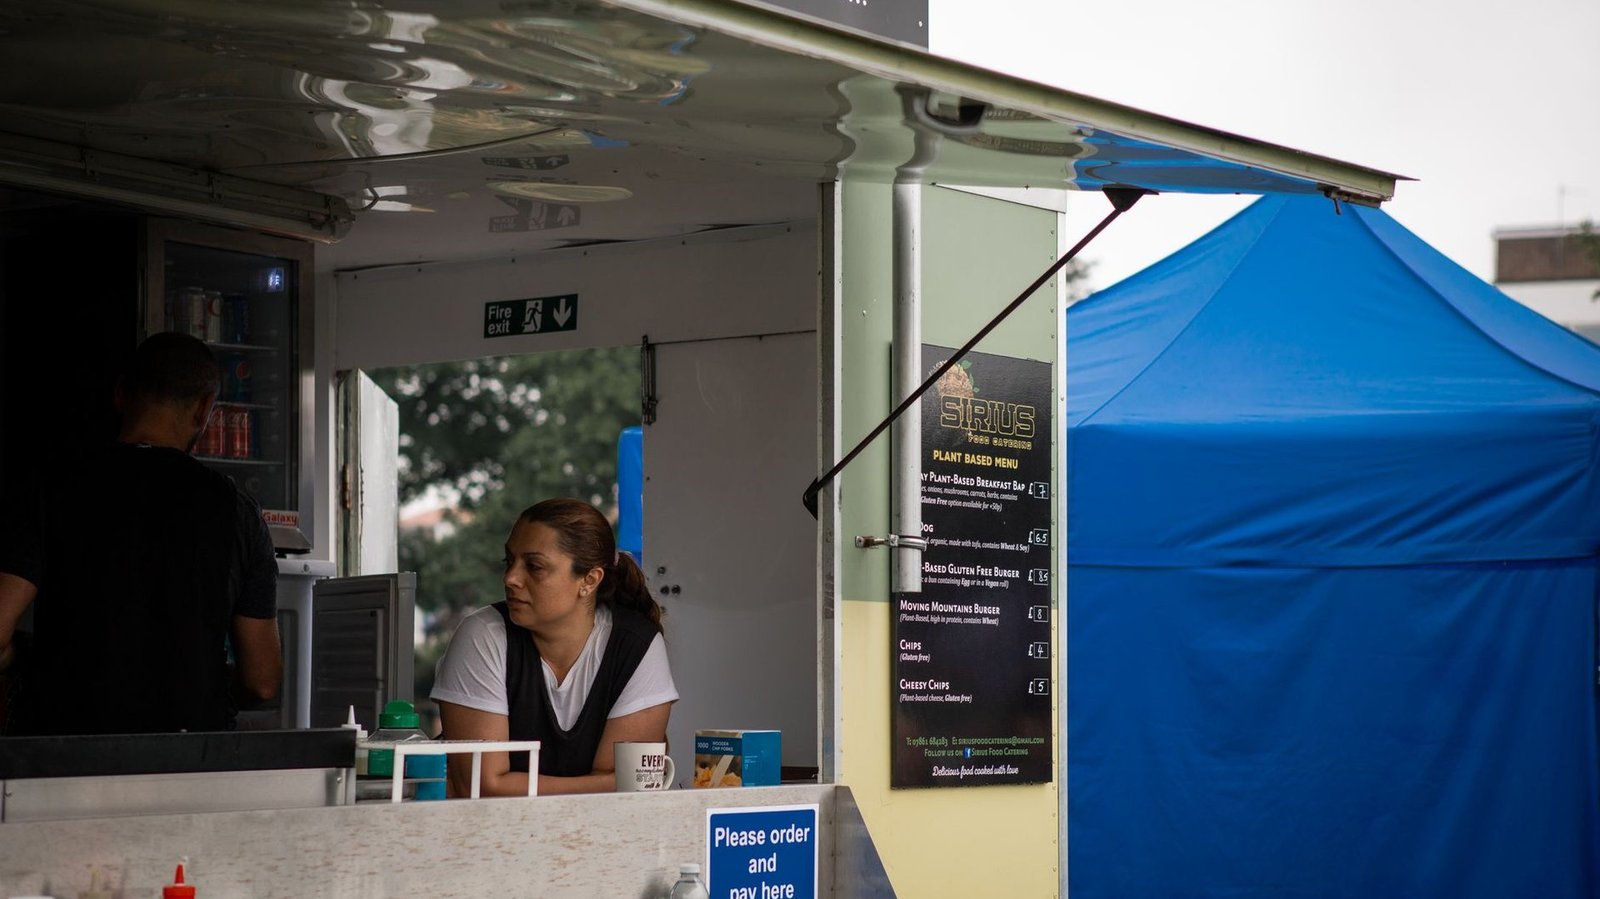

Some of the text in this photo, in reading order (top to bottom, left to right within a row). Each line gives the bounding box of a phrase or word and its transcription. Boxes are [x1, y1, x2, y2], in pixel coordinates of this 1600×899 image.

[488, 305, 512, 320] Fire
[488, 320, 510, 334] exit
[941, 394, 1034, 437] SIRIUS
[968, 434, 1032, 450] FOOD CATERING
[933, 450, 1018, 470] PLANT BASED MENU
[944, 487, 969, 496] mushrooms,
[962, 500, 982, 508] available
[264, 512, 298, 526] Galaxy
[1000, 542, 1015, 550] Wheat
[938, 577, 960, 586] containing
[961, 578, 970, 587] Egg
[985, 580, 998, 588] Vegan
[930, 615, 940, 624] high
[1038, 644, 1044, 658] 4
[918, 654, 930, 663] free)
[1038, 681, 1044, 692] 5
[960, 694, 972, 703] free)
[932, 764, 1019, 779] Delicious food cooked with love
[715, 824, 810, 848] Please order
[748, 852, 776, 873] and
[730, 881, 794, 899] pay here
